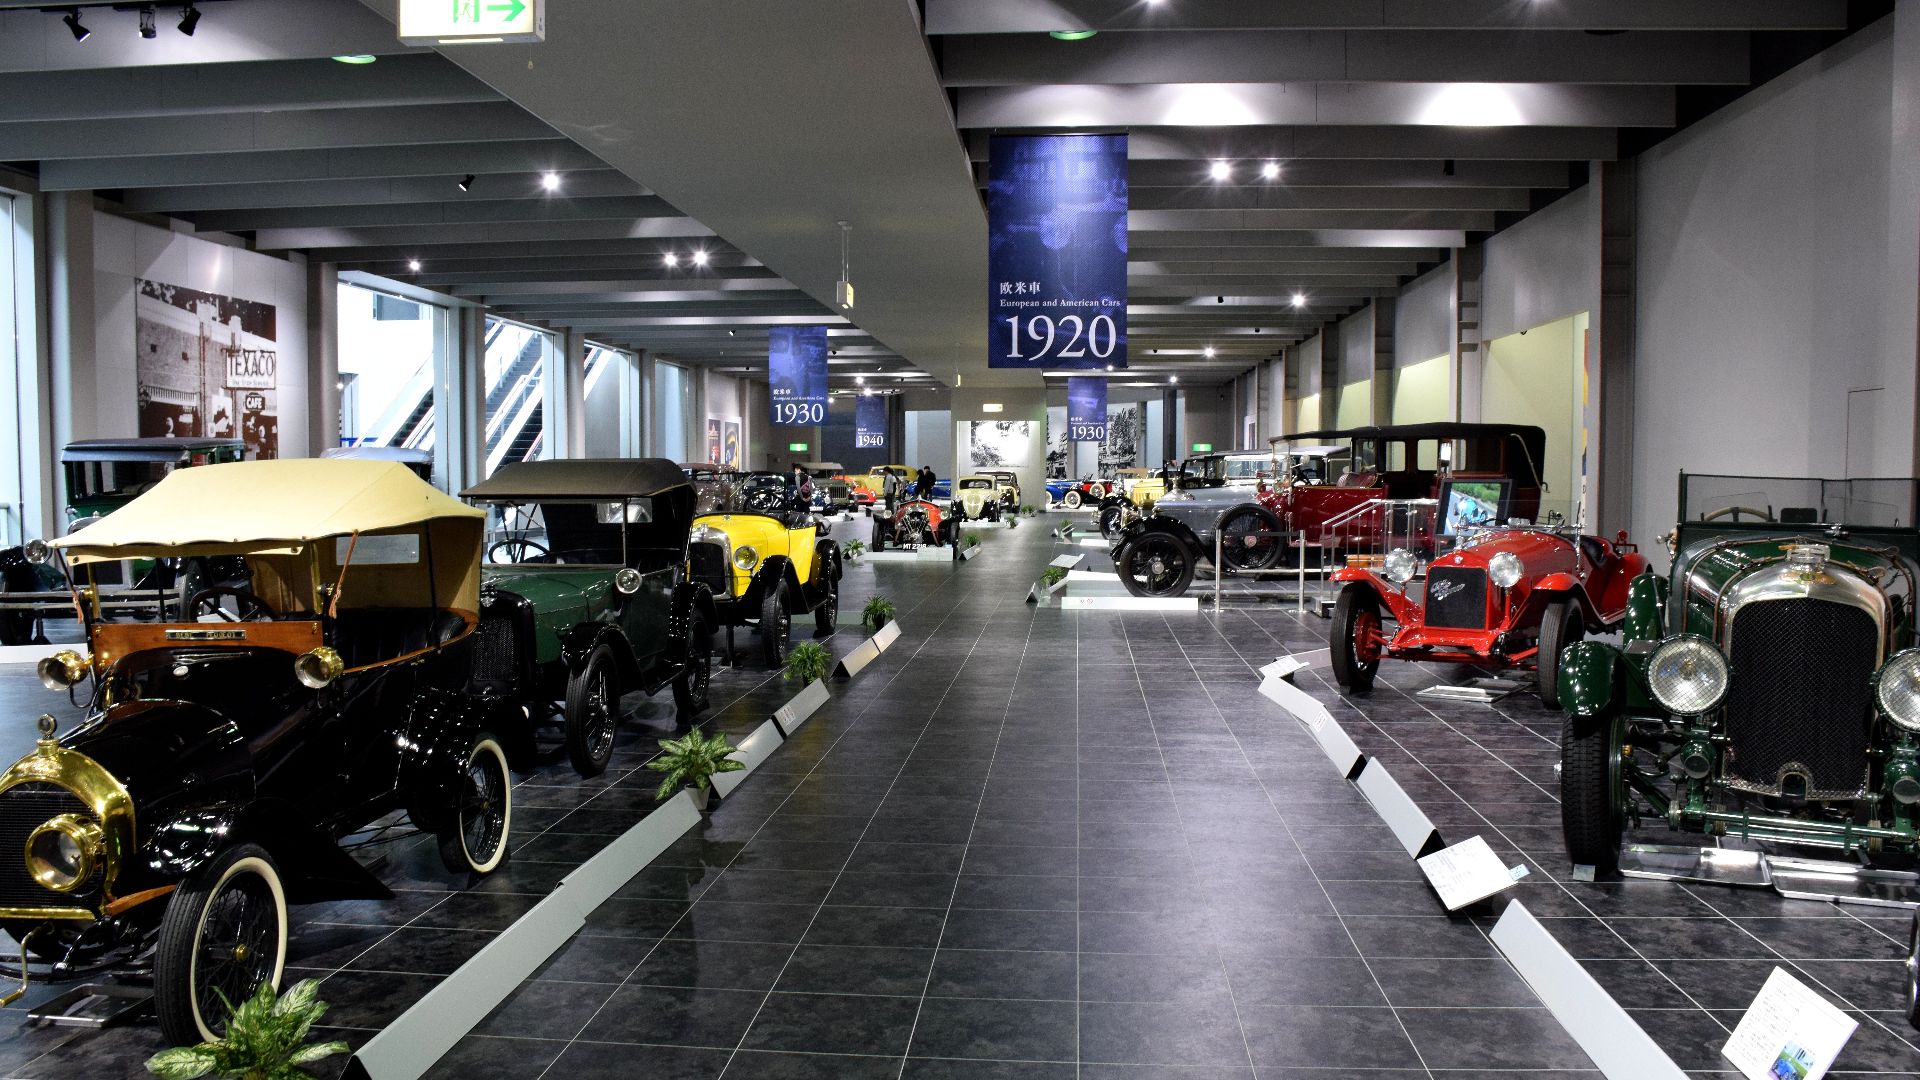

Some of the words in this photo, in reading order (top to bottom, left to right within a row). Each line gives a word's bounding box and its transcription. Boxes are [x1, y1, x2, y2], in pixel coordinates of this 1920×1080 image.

[1000, 281, 1041, 295] 欧米車
[1000, 299, 1040, 309] European
[1042, 299, 1057, 307] and
[1060, 299, 1099, 307] American
[1101, 299, 1120, 307] Cars
[1005, 315, 1116, 361] 1920
[230, 350, 274, 376] TEXACO
[246, 396, 262, 409] CAFE
[774, 403, 824, 424] 1930
[858, 434, 884, 446] 1940
[1071, 426, 1104, 440] 1930
